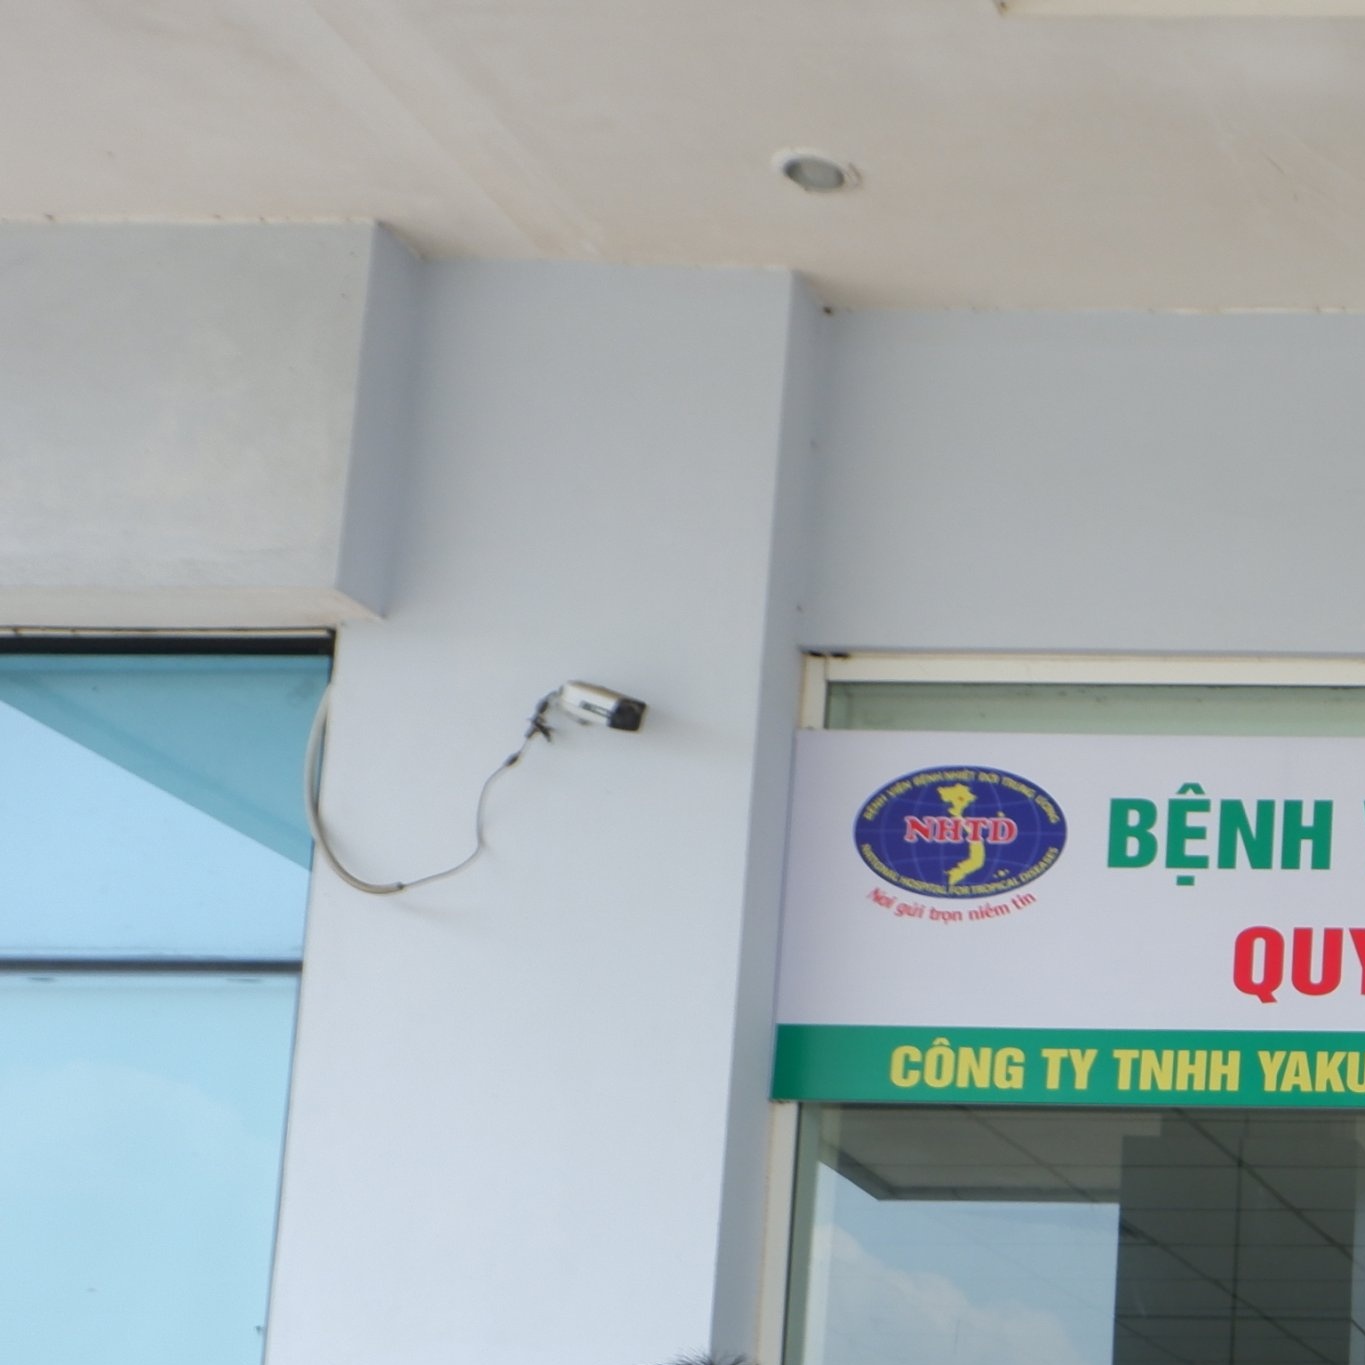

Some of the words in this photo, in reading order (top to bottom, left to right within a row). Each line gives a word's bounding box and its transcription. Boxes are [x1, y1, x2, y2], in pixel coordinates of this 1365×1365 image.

[904, 815, 1018, 844] NHTD
[1106, 782, 1334, 887] BỆNH
[929, 906, 963, 924] trọn
[1011, 893, 1036, 910] tin
[891, 1038, 1023, 1089] CÔNG
[1043, 1048, 1096, 1089] TY
[1114, 1049, 1240, 1091] TNHH
